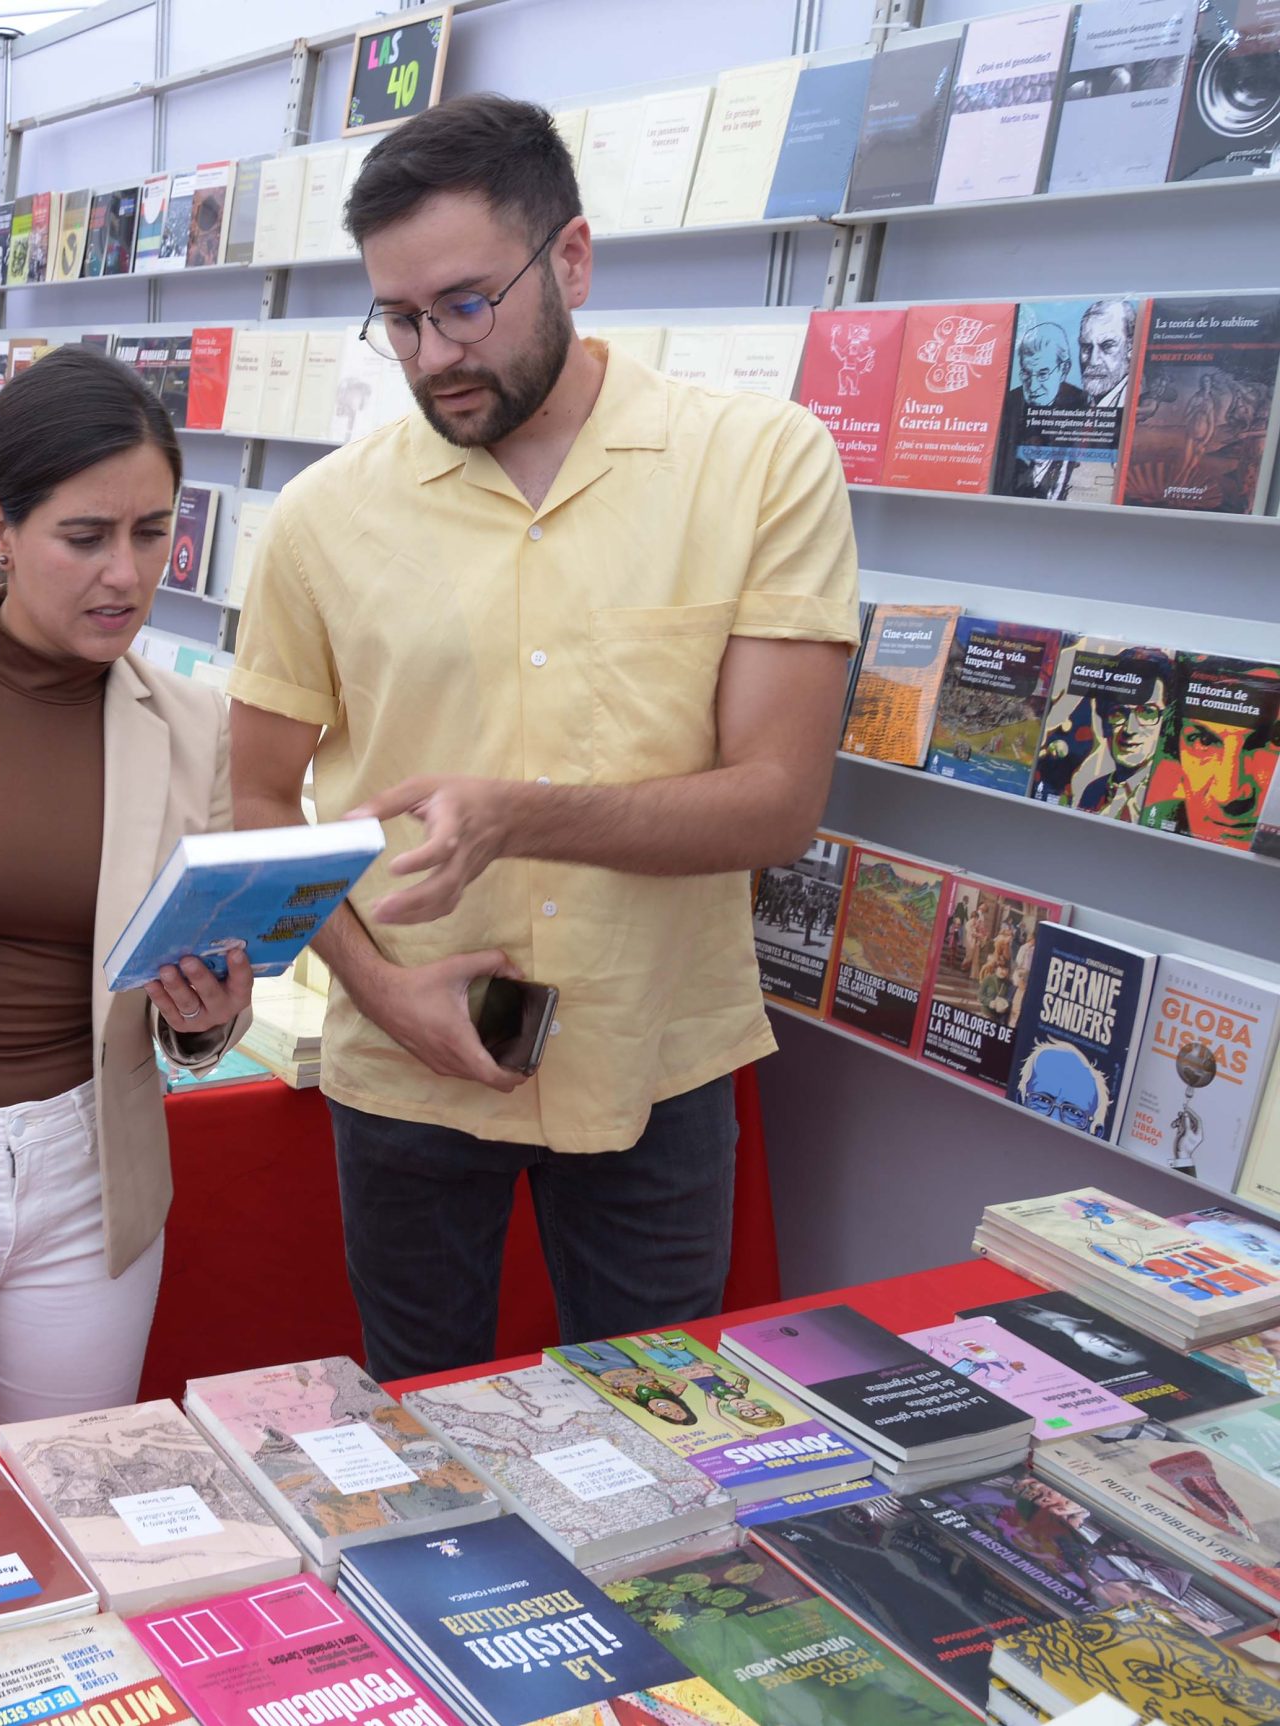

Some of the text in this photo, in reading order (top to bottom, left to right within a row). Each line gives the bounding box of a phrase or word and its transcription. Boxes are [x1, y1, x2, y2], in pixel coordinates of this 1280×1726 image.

[368, 30, 402, 70] LAS
[1012, 52, 1051, 69] genocidio?
[387, 60, 419, 109] 40
[1155, 317, 1260, 329] La teoría de lo sublime
[902, 397, 944, 414] Álvaro
[1038, 408, 1051, 417] tres
[1052, 407, 1085, 417] instancias
[1096, 408, 1116, 418] Freud
[842, 418, 880, 434] Linera
[899, 416, 989, 433] García Linera
[1031, 418, 1115, 429] los tres registros Lacan
[924, 441, 938, 450] una
[899, 452, 983, 465] otros ensayos reunidos
[882, 629, 933, 641] Cine-capital
[968, 645, 1026, 663] Modo de vida
[965, 656, 1003, 671] imperial
[1073, 666, 1142, 686] Cárcel exilio
[1070, 678, 1131, 694] Historia comunista
[1187, 682, 1248, 702] Historia de
[1185, 695, 1260, 716] un comunista
[791, 952, 825, 970] VISIBILIDAD
[838, 977, 850, 989] DEL
[851, 981, 878, 999] CAPITAL
[839, 964, 853, 977] LOS
[854, 968, 887, 991] TALLERES
[887, 982, 919, 1003] OCULTOS
[1045, 956, 1122, 1017] BERNIE
[932, 1002, 1013, 1043] LOS VALORES DE
[1040, 993, 1115, 1045] SANDERS
[1161, 998, 1253, 1049] GLOBA
[929, 1017, 943, 1033] LA
[944, 1023, 982, 1049] FAMILIA
[1154, 1021, 1249, 1074] LISTAS
[924, 1049, 967, 1073] Melinda Cooper
[1135, 1111, 1154, 1124] NEO
[1131, 1130, 1158, 1146] LISMO
[1133, 1120, 1163, 1139] LIBERA
[865, 1370, 942, 1397] en Argentina
[920, 1383, 941, 1394] lesa
[862, 1387, 923, 1408] humanidad
[905, 1391, 959, 1408] los delitos
[874, 1395, 989, 1427] La violencia de género
[723, 1432, 844, 1465] JÓVENAS
[763, 1448, 854, 1469] FEMINISMO PARA
[782, 1480, 873, 1505] FEMINISMO PARA
[1101, 1478, 1206, 1543] PUTAS, REPÚBLICA
[968, 1529, 1078, 1603] MASCULINIDADES
[448, 1588, 489, 1602] FONSECA
[440, 1589, 585, 1636] masculina
[340, 1634, 365, 1648] Laura
[463, 1612, 623, 1673] ilusión
[780, 1635, 857, 1665] VIRGINIA
[61, 1644, 100, 1662] GRIMSON
[66, 1649, 115, 1671] ALEJANDRO
[936, 1641, 993, 1663] Beauvoir
[10, 1666, 25, 1675] PARA
[26, 1658, 55, 1670] DESECHAR
[33, 1667, 51, 1679] DESEO
[561, 1654, 617, 1683] La
[756, 1647, 870, 1690] POR LONDRES
[820, 1659, 885, 1687] PASEOS
[1, 1677, 19, 1689] PODER
[35, 1675, 52, 1686] IDEAS
[52, 1672, 66, 1680] LAS
[74, 1668, 97, 1681] FAUR
[80, 1672, 119, 1691] ELEONOR
[6, 1684, 21, 1695] SIGLO
[22, 1681, 35, 1690] DEL
[26, 1696, 53, 1713] LOS
[54, 1690, 76, 1706] DE
